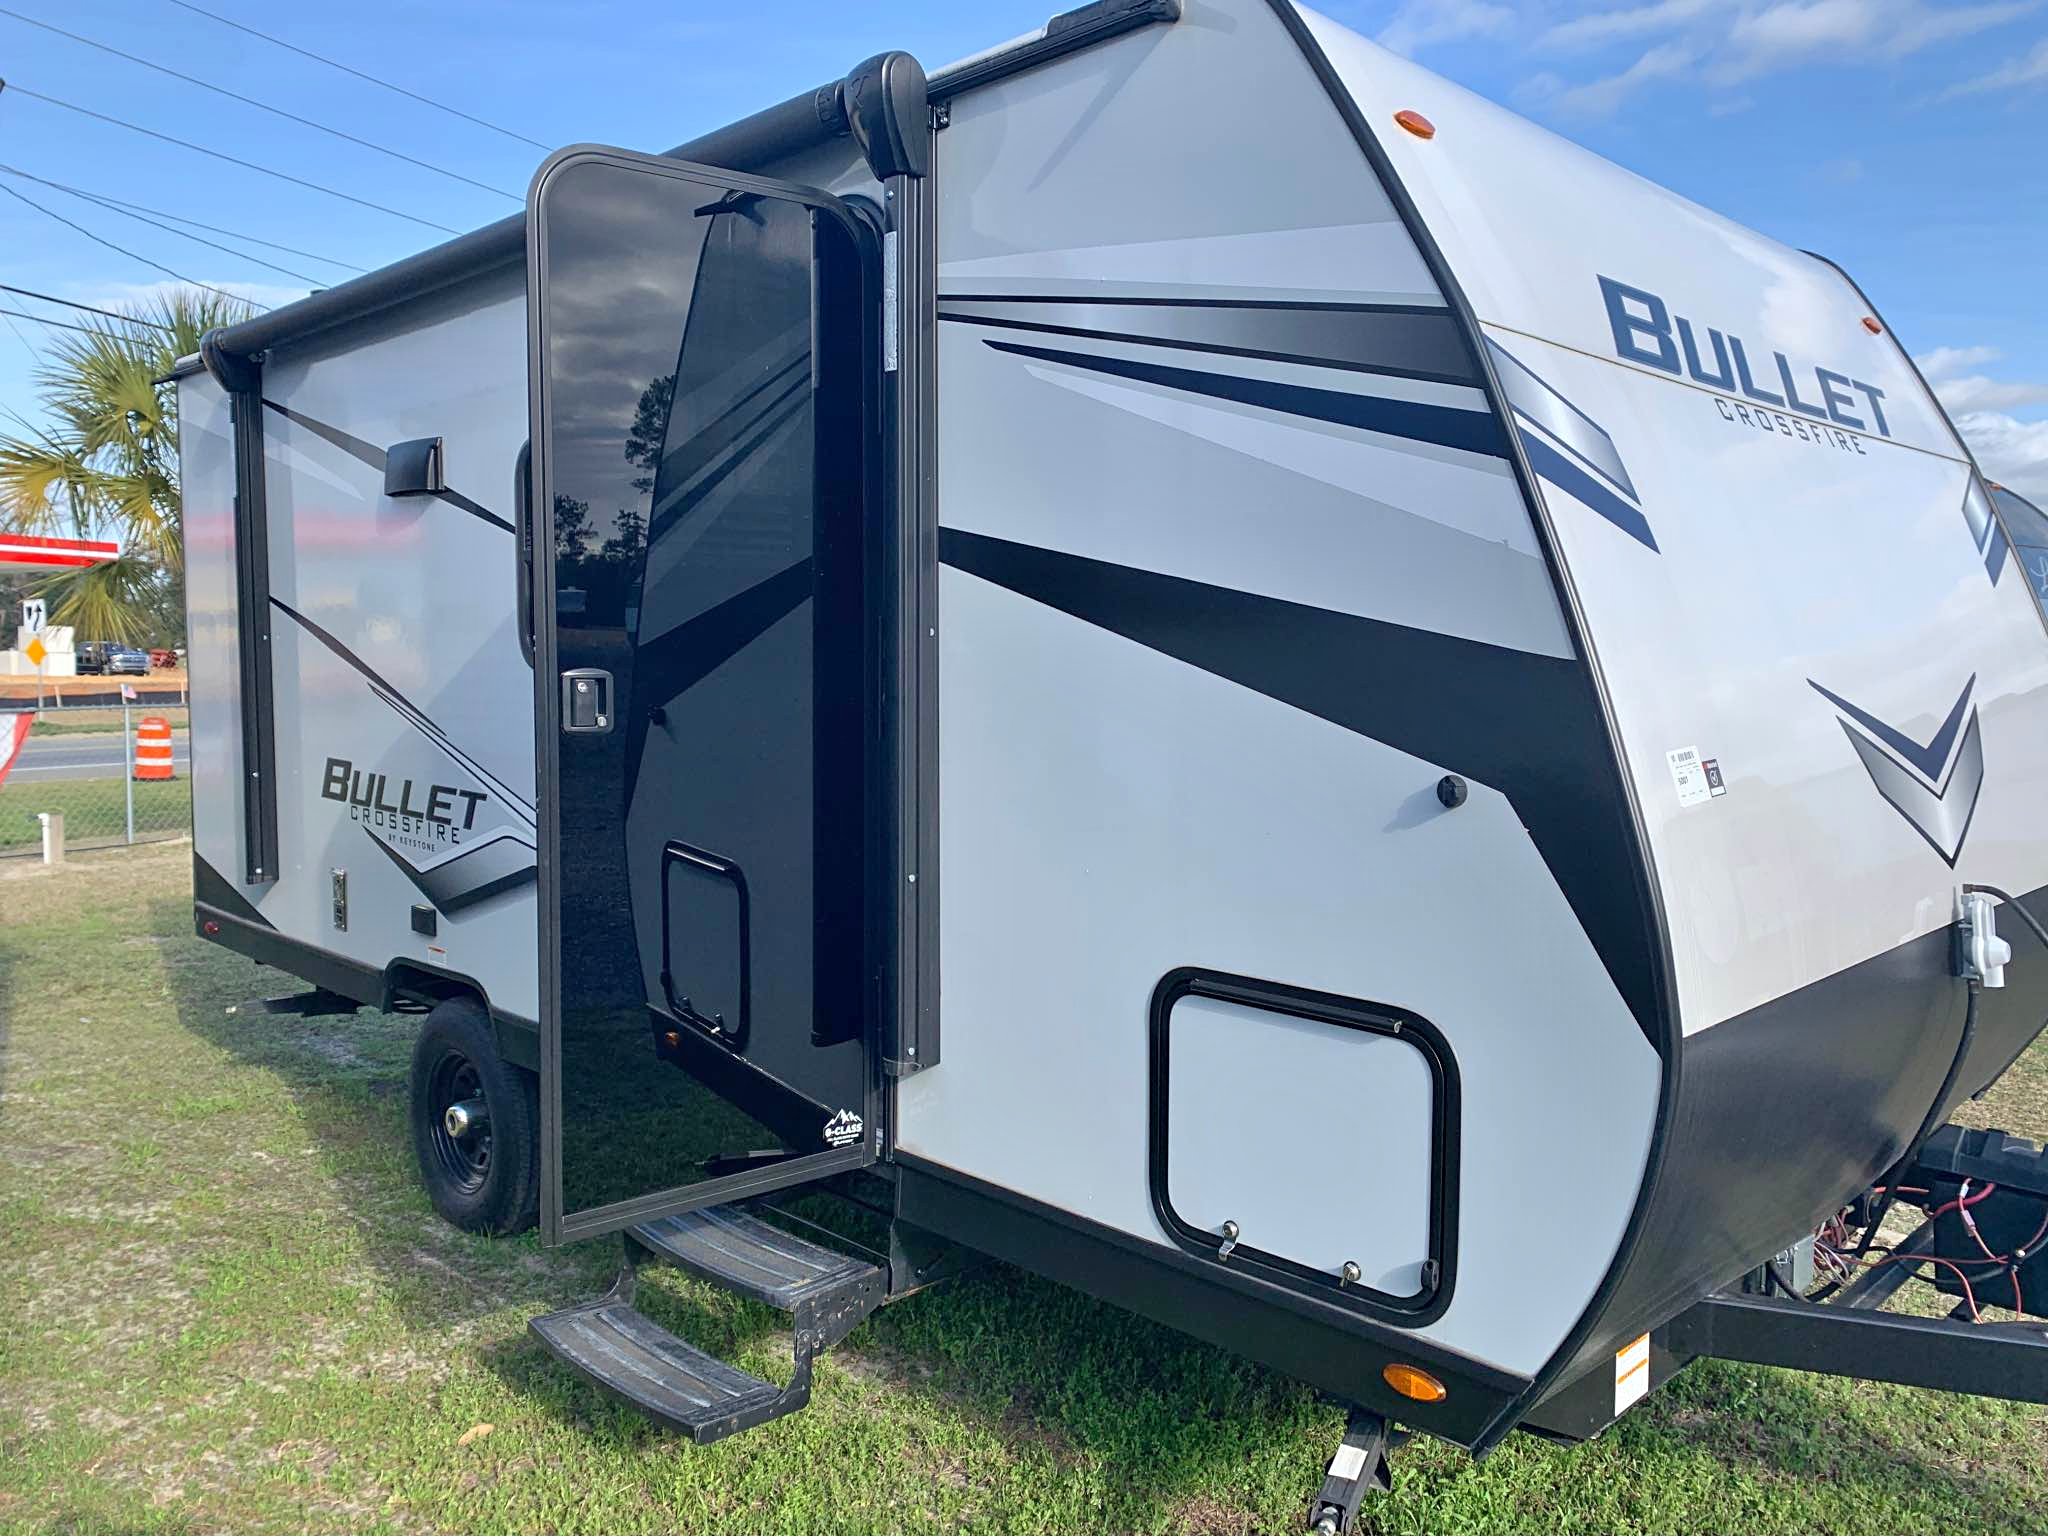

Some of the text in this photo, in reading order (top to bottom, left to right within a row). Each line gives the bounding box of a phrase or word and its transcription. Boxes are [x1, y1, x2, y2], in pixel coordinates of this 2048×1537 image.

[1596, 273, 1891, 438] BULLET
[1714, 397, 1867, 456] CROSSFIRE
[321, 757, 488, 831] BULLET
[350, 805, 461, 845] CROSSFIRE
[399, 836, 436, 852] KEYSTONE
